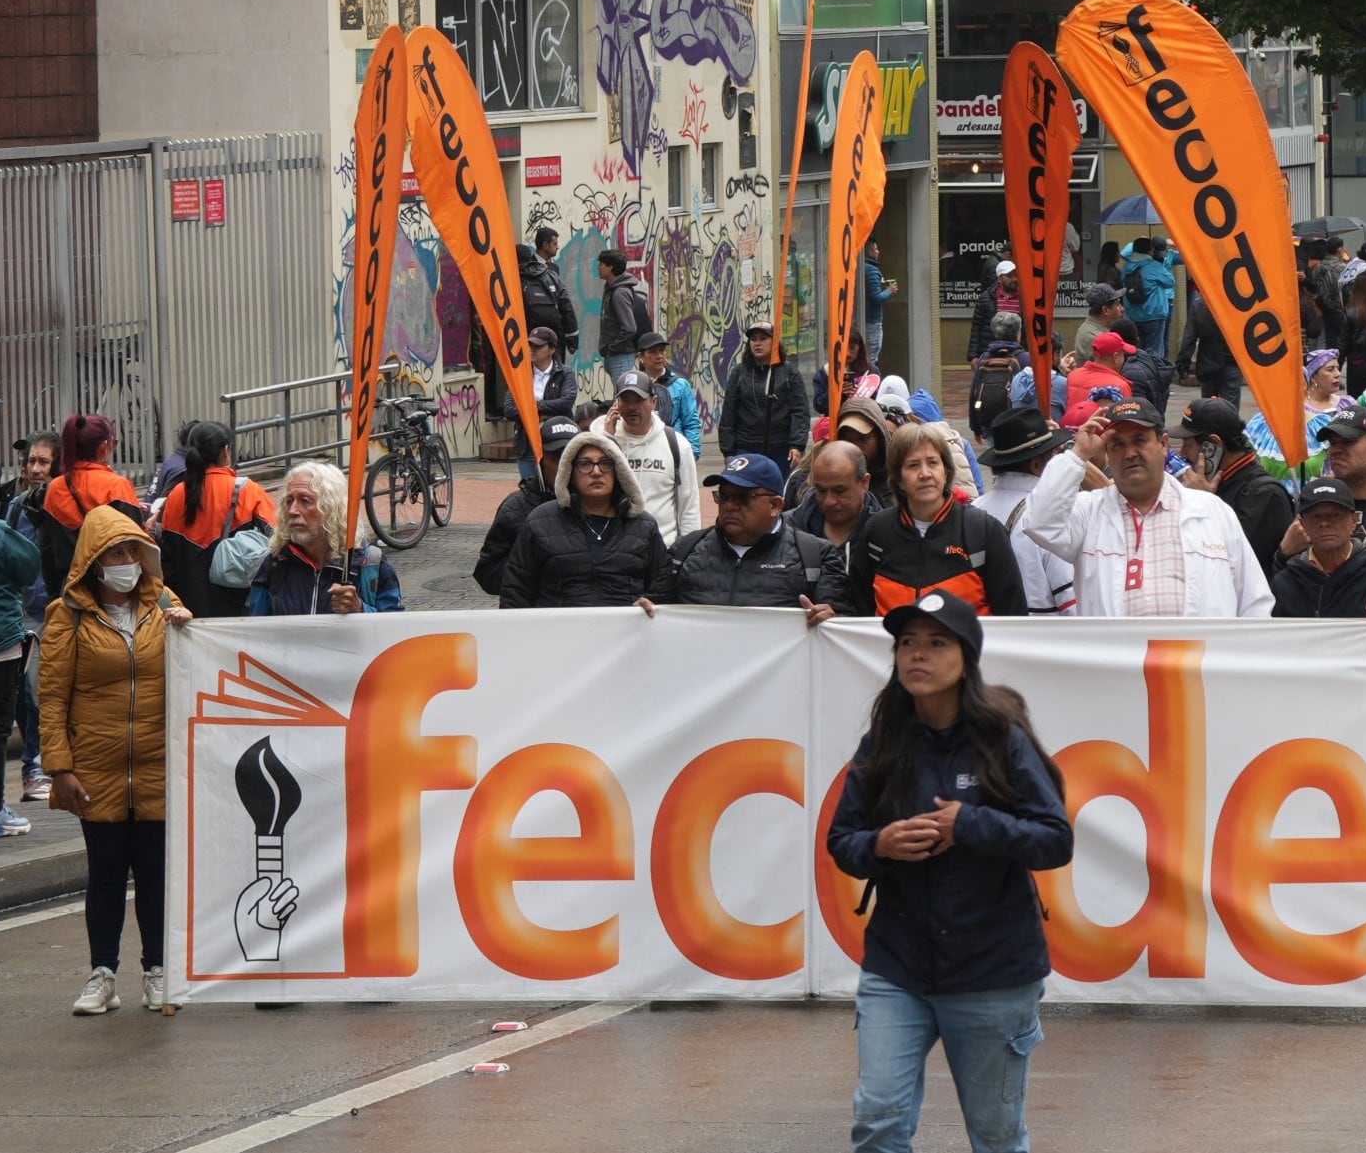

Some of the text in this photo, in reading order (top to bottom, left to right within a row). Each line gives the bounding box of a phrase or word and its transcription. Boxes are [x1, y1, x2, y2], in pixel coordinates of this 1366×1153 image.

[356, 47, 395, 440] fecode
[422, 44, 524, 369] fecode
[526, 159, 561, 176] REGISTRO CIVIL
[1126, 4, 1288, 367] fecode
